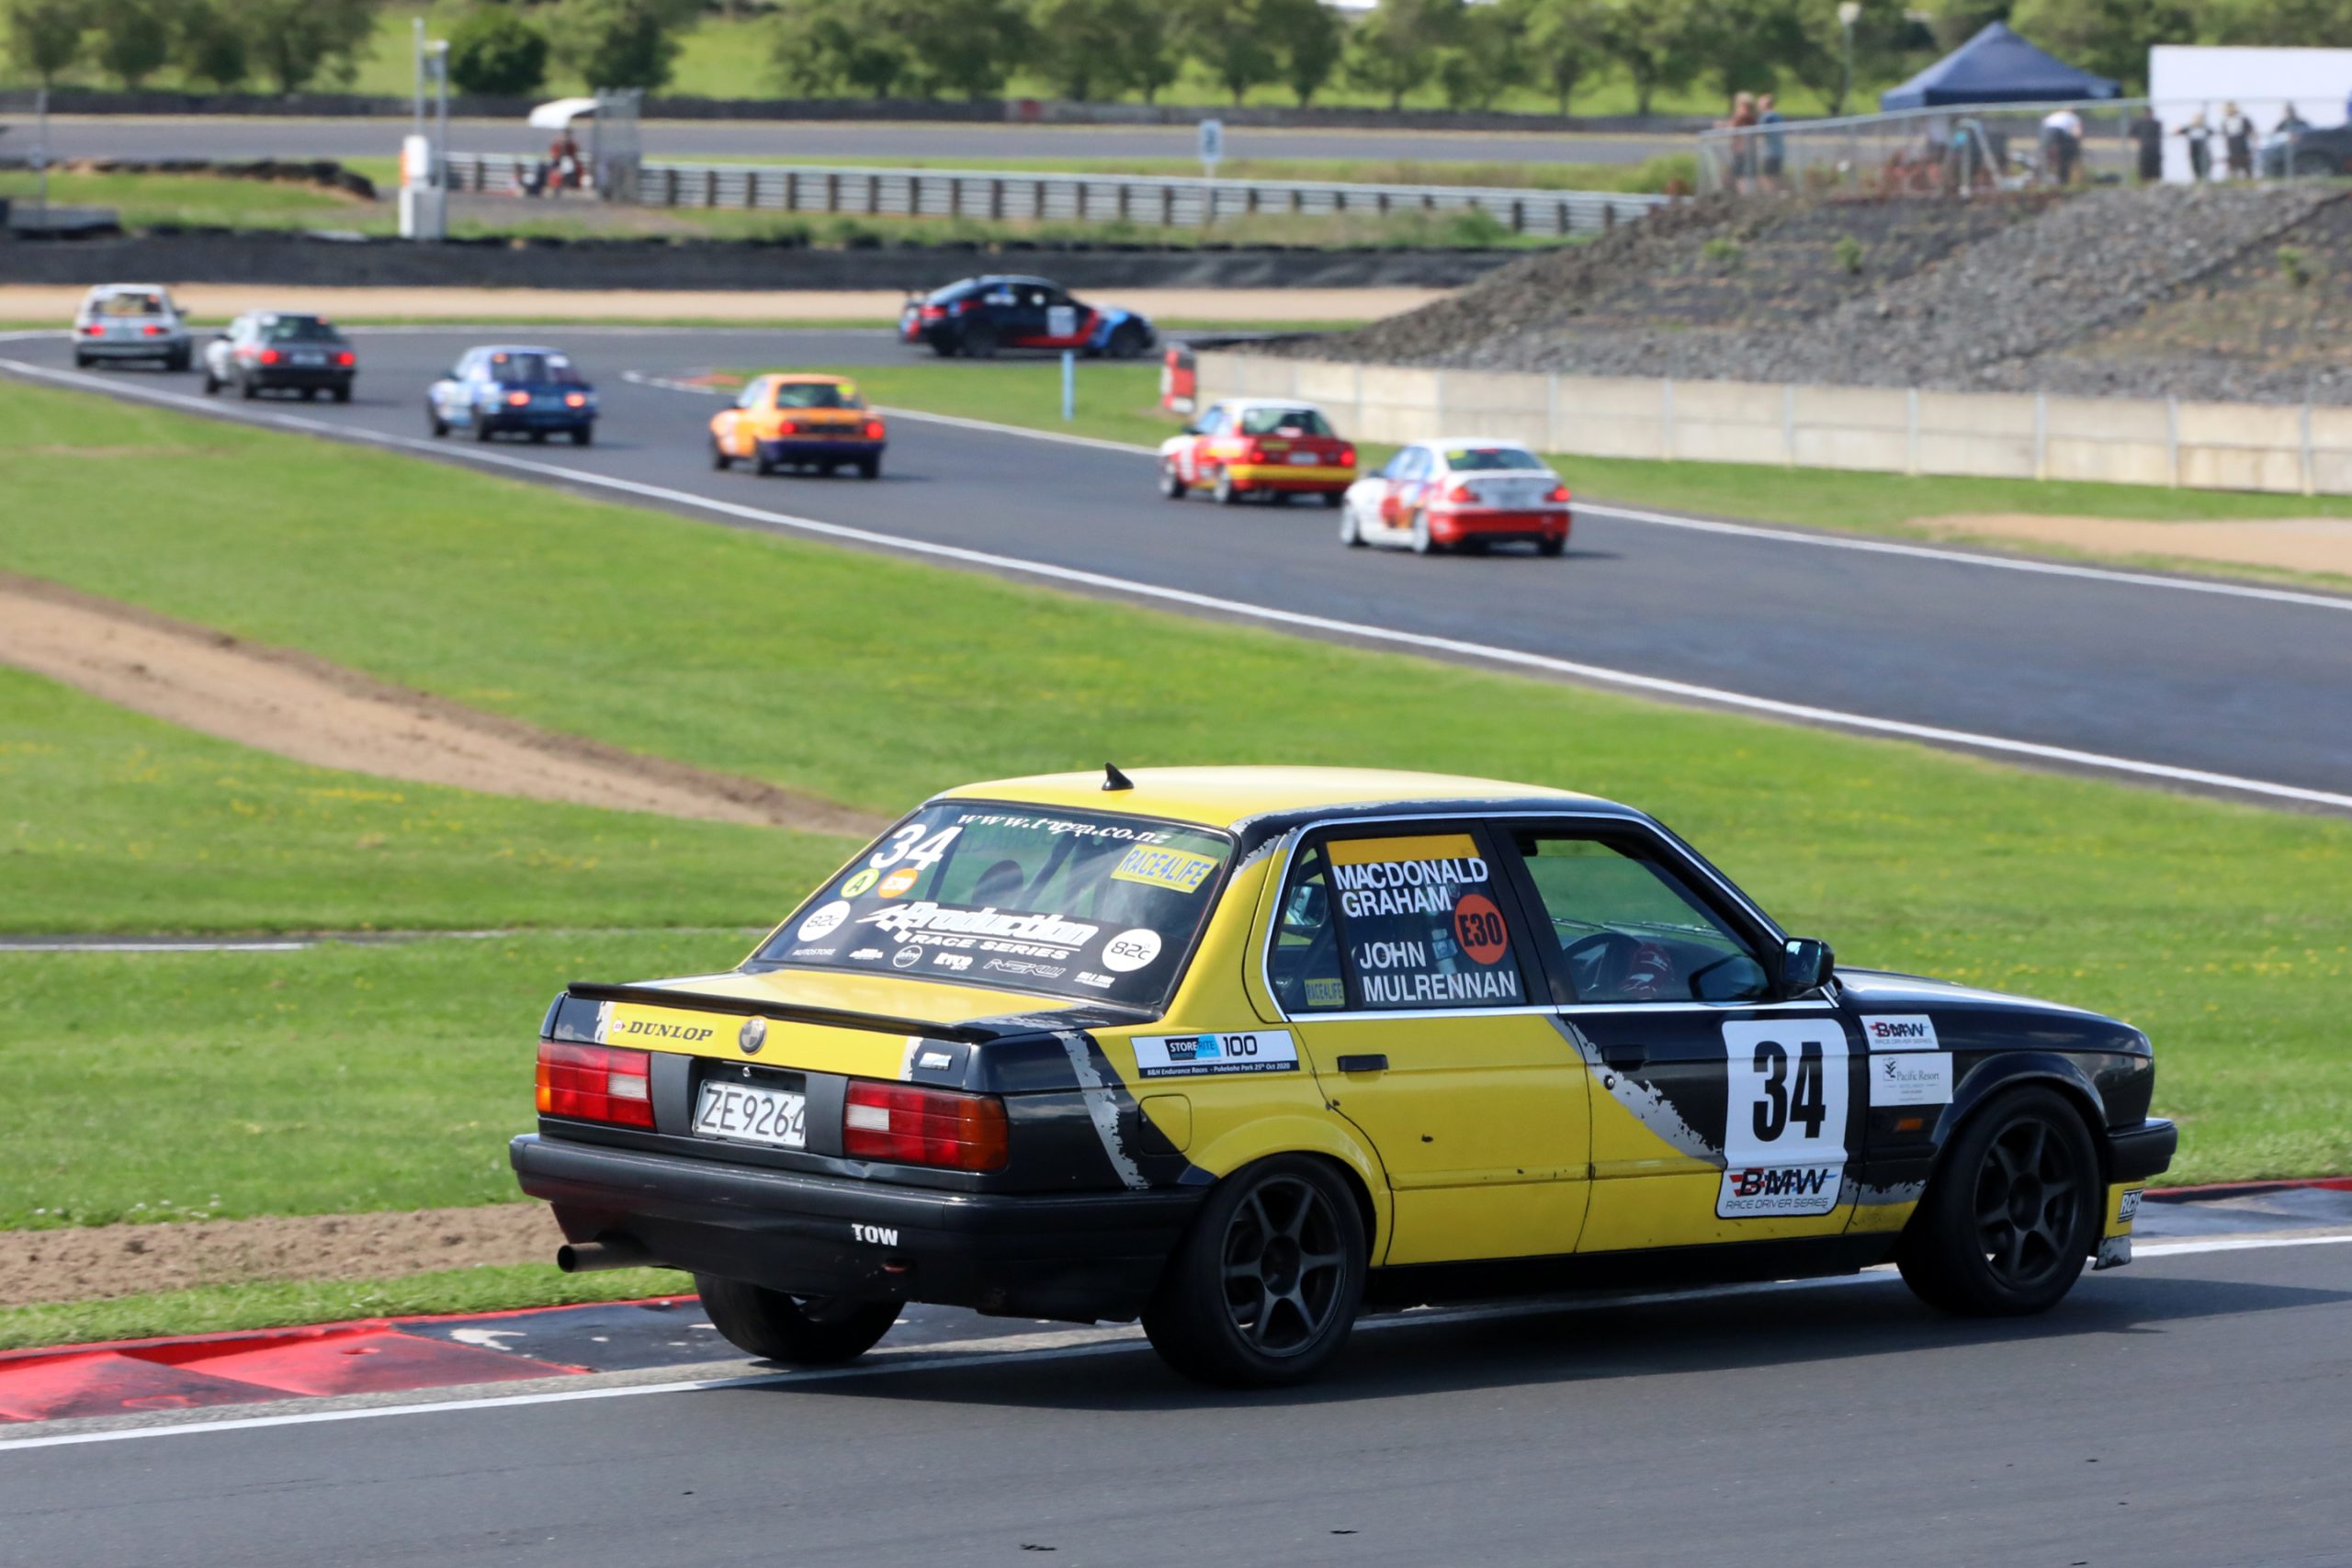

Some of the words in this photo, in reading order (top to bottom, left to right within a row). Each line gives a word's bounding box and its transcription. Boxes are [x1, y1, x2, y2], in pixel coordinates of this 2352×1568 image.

[870, 824, 963, 871] 34
[1119, 850, 1212, 886] RACE4LIFE
[1333, 858, 1488, 891] MACDONALD
[847, 875, 868, 892] A
[1341, 886, 1453, 918] GRAHAM
[908, 901, 1099, 946] Production
[1458, 913, 1501, 947] E30
[909, 935, 977, 948] RACE
[979, 940, 1069, 961] SERIES
[1359, 942, 1426, 970] JOHN
[1363, 971, 1517, 1002] MULRENNAN
[628, 1021, 713, 1041] DUNLOP
[1876, 1022, 1924, 1037] BMW
[1223, 1035, 1258, 1056] 100
[1897, 1070, 1917, 1080] Pacific
[1918, 1070, 1939, 1080] Resort
[1753, 1041, 1826, 1141] 34
[701, 1089, 806, 1140] ZE9264
[1740, 1168, 1828, 1197] BMW
[1726, 1200, 1753, 1209] RACE
[1755, 1199, 1792, 1209] DRIVER
[1793, 1198, 1828, 1208] SERIES
[852, 1224, 898, 1247] TOW
